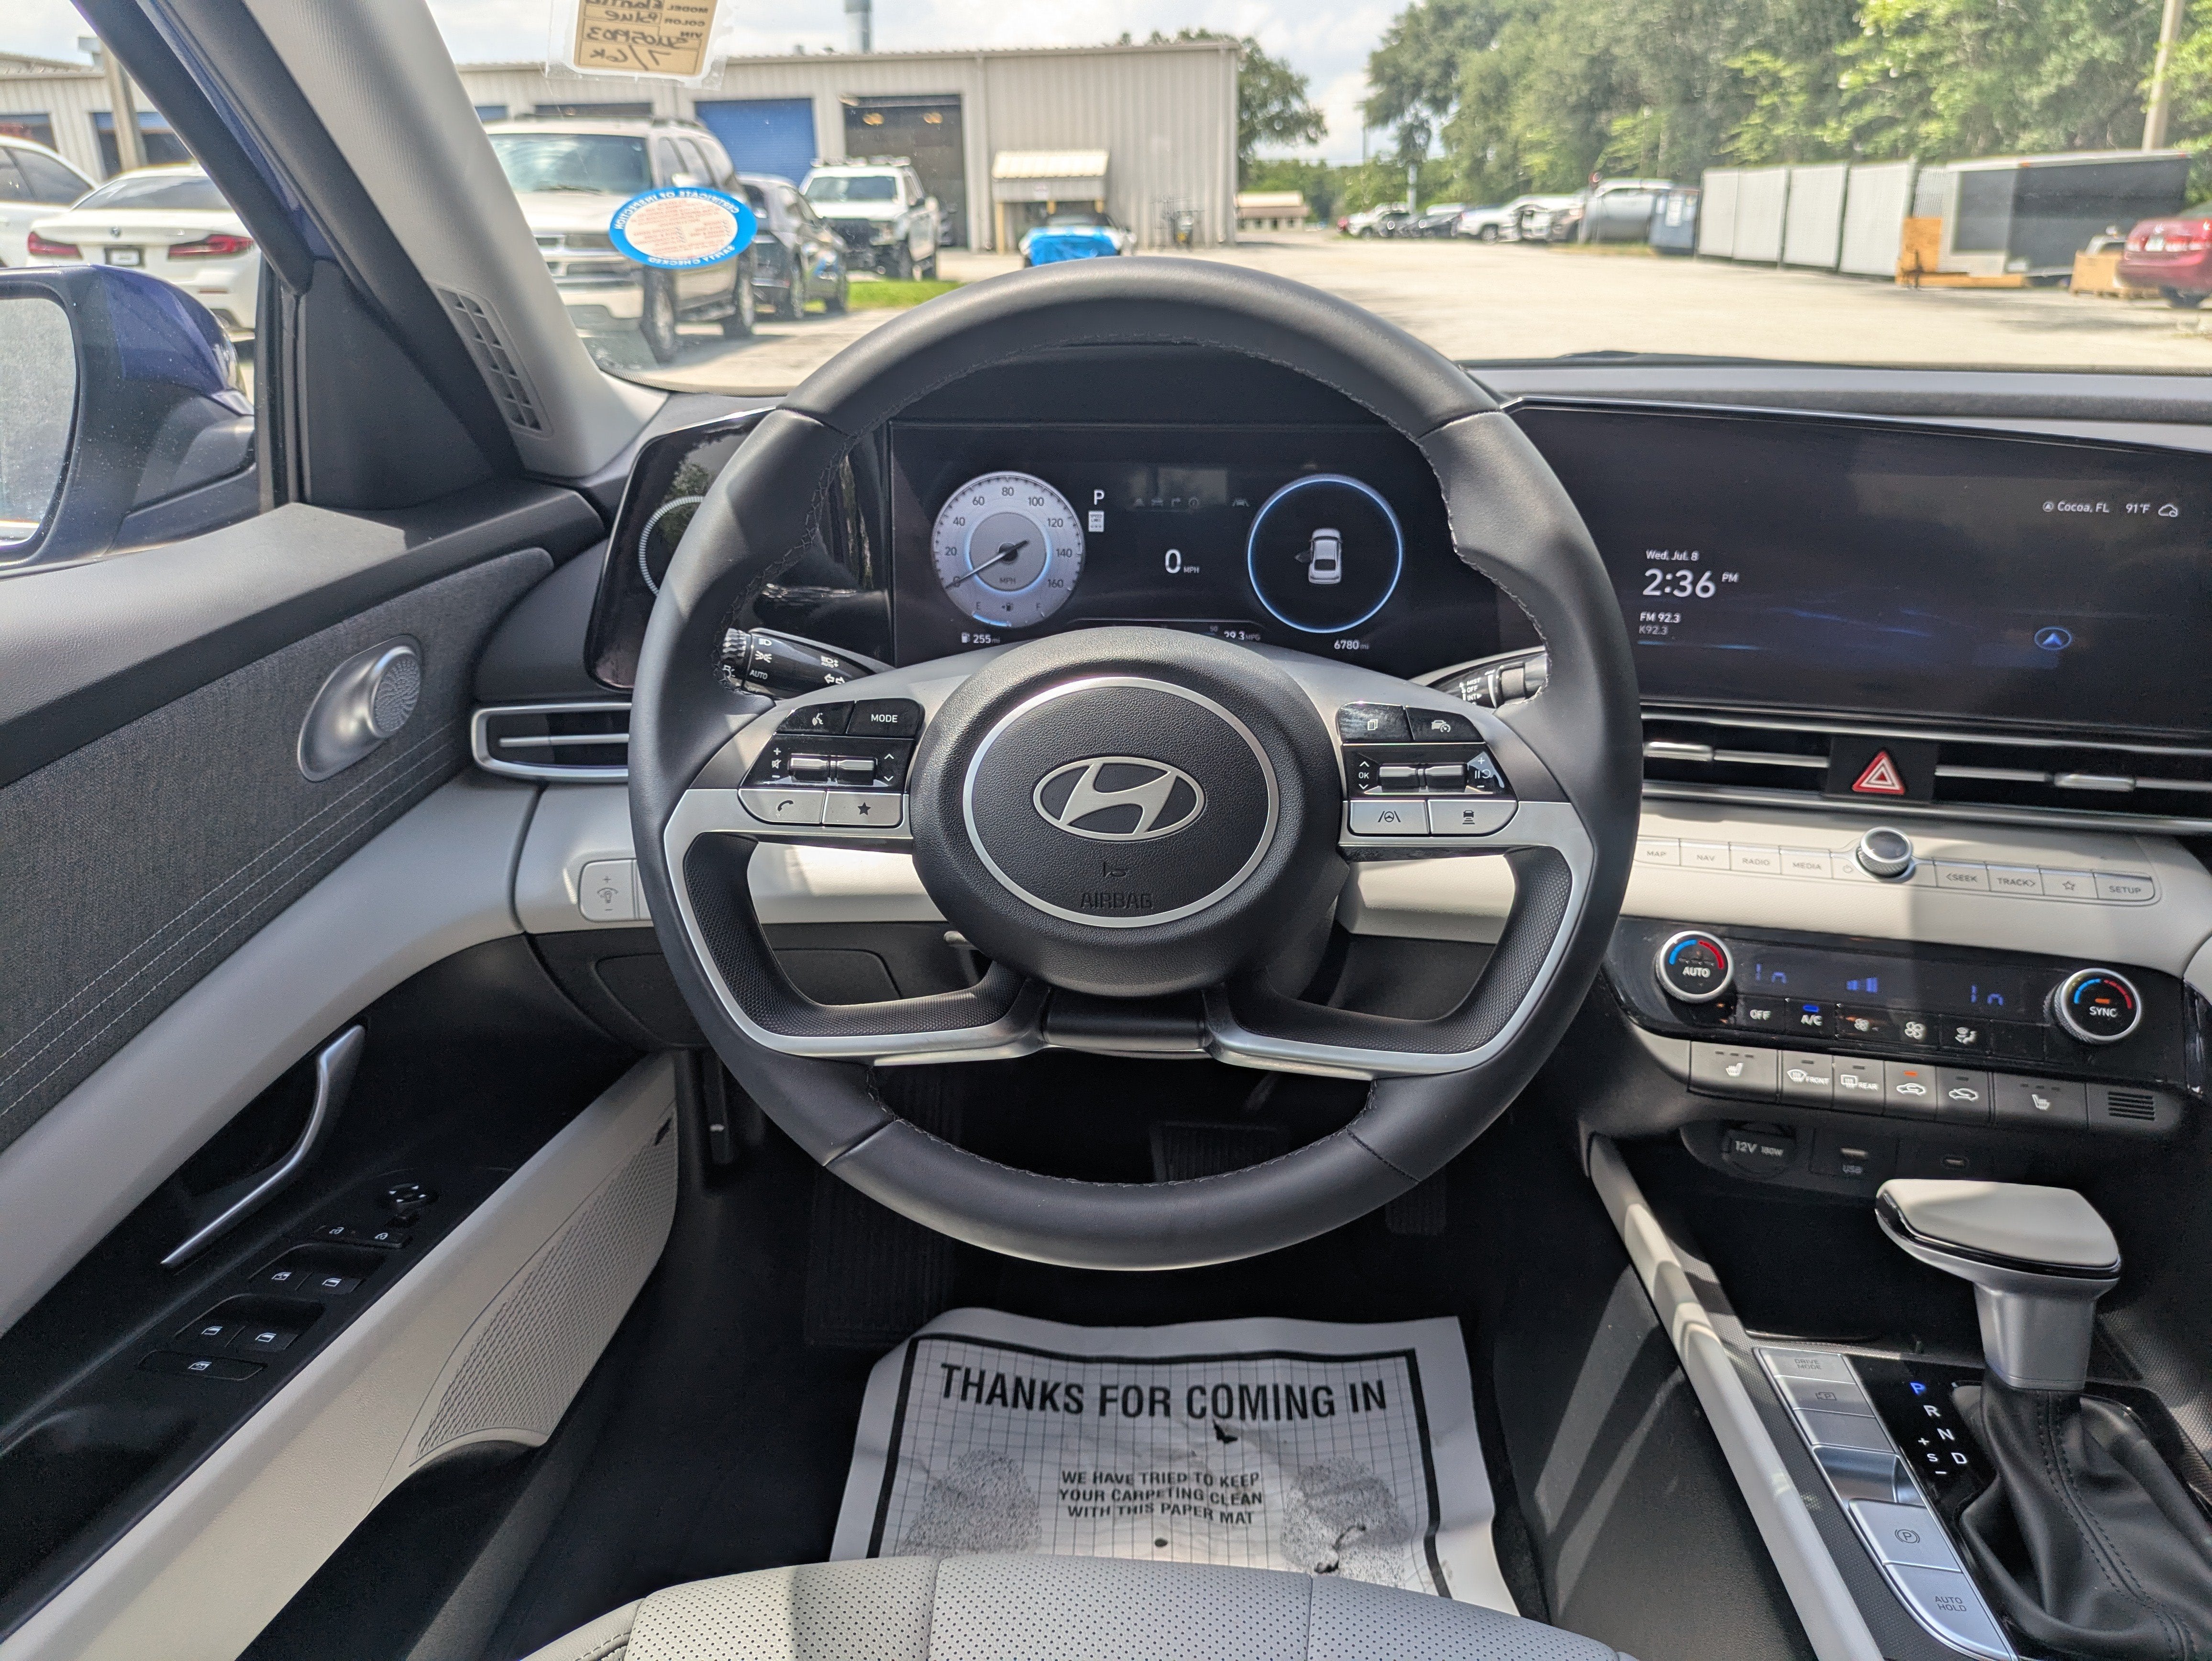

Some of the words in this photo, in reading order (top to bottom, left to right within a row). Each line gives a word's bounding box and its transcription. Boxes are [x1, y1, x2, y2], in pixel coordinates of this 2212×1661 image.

[1002, 487, 1014, 497] 80
[1094, 489, 1105, 505] P
[973, 497, 985, 506] 60
[1028, 497, 1044, 506] 100
[2057, 501, 2092, 513] Cocoa,
[2095, 502, 2110, 513] FL
[953, 517, 966, 527] 40
[1048, 518, 1063, 528] 120
[945, 547, 957, 556] 20
[1056, 549, 1073, 558] 140
[1691, 550, 1699, 561] 8
[1164, 549, 1182, 573] 0
[1048, 579, 1063, 588] 160
[1643, 568, 1716, 598] 2:36
[1722, 572, 1739, 582] PM
[1640, 611, 1656, 622] FM
[1658, 612, 1681, 623] 92.3
[1639, 625, 1668, 635] K92.3
[973, 633, 991, 643] 255
[1334, 640, 1360, 650] 6780
[749, 669, 768, 680] AUTO
[1467, 676, 1481, 686] MIST
[1467, 684, 1478, 693] OFF
[1467, 693, 1477, 701] INT
[871, 714, 898, 723] MODE
[1358, 772, 1370, 780] OK
[1742, 857, 1770, 867] RADIO
[1792, 862, 1822, 870] MEDIA
[2109, 886, 2141, 895] SETUP
[1080, 891, 1155, 910] AIRBAG
[1682, 966, 1710, 978] AUTO
[1750, 1009, 1771, 1020] OFF
[2089, 1006, 2118, 1018] SYNC
[1801, 1014, 1823, 1027] A/C
[1805, 1075, 1830, 1085] FRONT
[1858, 1082, 1879, 1092] REAR
[1735, 1141, 1758, 1153] 12V
[1842, 1164, 1863, 1174] USB
[940, 1362, 1084, 1415] THANKS
[1100, 1384, 1171, 1418] FOR
[1186, 1382, 1335, 1421] COMING
[1349, 1380, 1386, 1413] IN
[1910, 1382, 1927, 1395] P
[1923, 1405, 1941, 1418] R
[1937, 1428, 1956, 1441] N
[1927, 1453, 1939, 1462] S
[1951, 1452, 1968, 1464] D
[1062, 1471, 1085, 1484] WE
[1093, 1471, 1133, 1485] HAVE
[1139, 1471, 1188, 1485] TRIED
[1195, 1472, 1214, 1486] TO
[1219, 1472, 1260, 1489] KEEP
[1059, 1488, 1105, 1502] YOUR
[1111, 1486, 1204, 1502] CARPETING
[1210, 1491, 1262, 1506] CLEAN
[1068, 1505, 1111, 1518] WITH
[1118, 1502, 1155, 1516] THIS
[1161, 1502, 1214, 1520] PAPER
[1219, 1511, 1255, 1525] MAT
[1935, 1595, 1962, 1604] AUTO
[1937, 1603, 1967, 1612] HOLD
